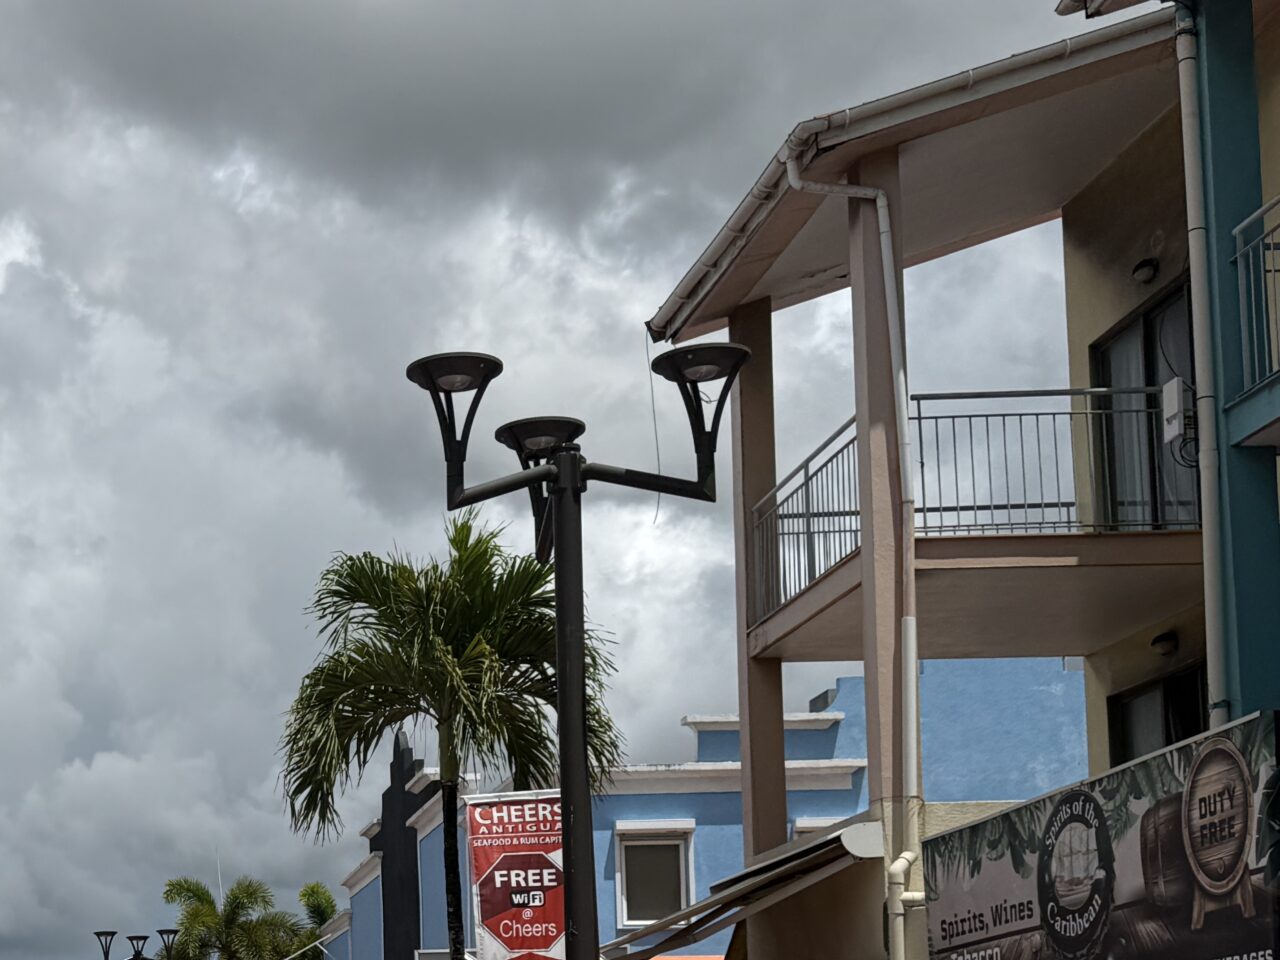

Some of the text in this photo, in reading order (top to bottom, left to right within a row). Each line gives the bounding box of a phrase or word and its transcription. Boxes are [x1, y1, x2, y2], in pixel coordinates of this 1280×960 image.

[1198, 787, 1238, 819] DUTY
[475, 803, 562, 824] CHEERS
[1045, 796, 1099, 850] Spirits of the
[479, 823, 562, 834] ANTIGUA
[1199, 816, 1237, 847] FREE
[473, 838, 511, 847] SEAFOOD
[513, 837, 519, 845] &
[520, 836, 538, 845] RUM
[494, 869, 558, 888] FREE
[512, 892, 543, 905] WiFi
[522, 909, 533, 919] @
[941, 900, 1034, 944] Spirits, Wines
[1047, 894, 1102, 937] Caribbean
[500, 920, 557, 937] Cheers
